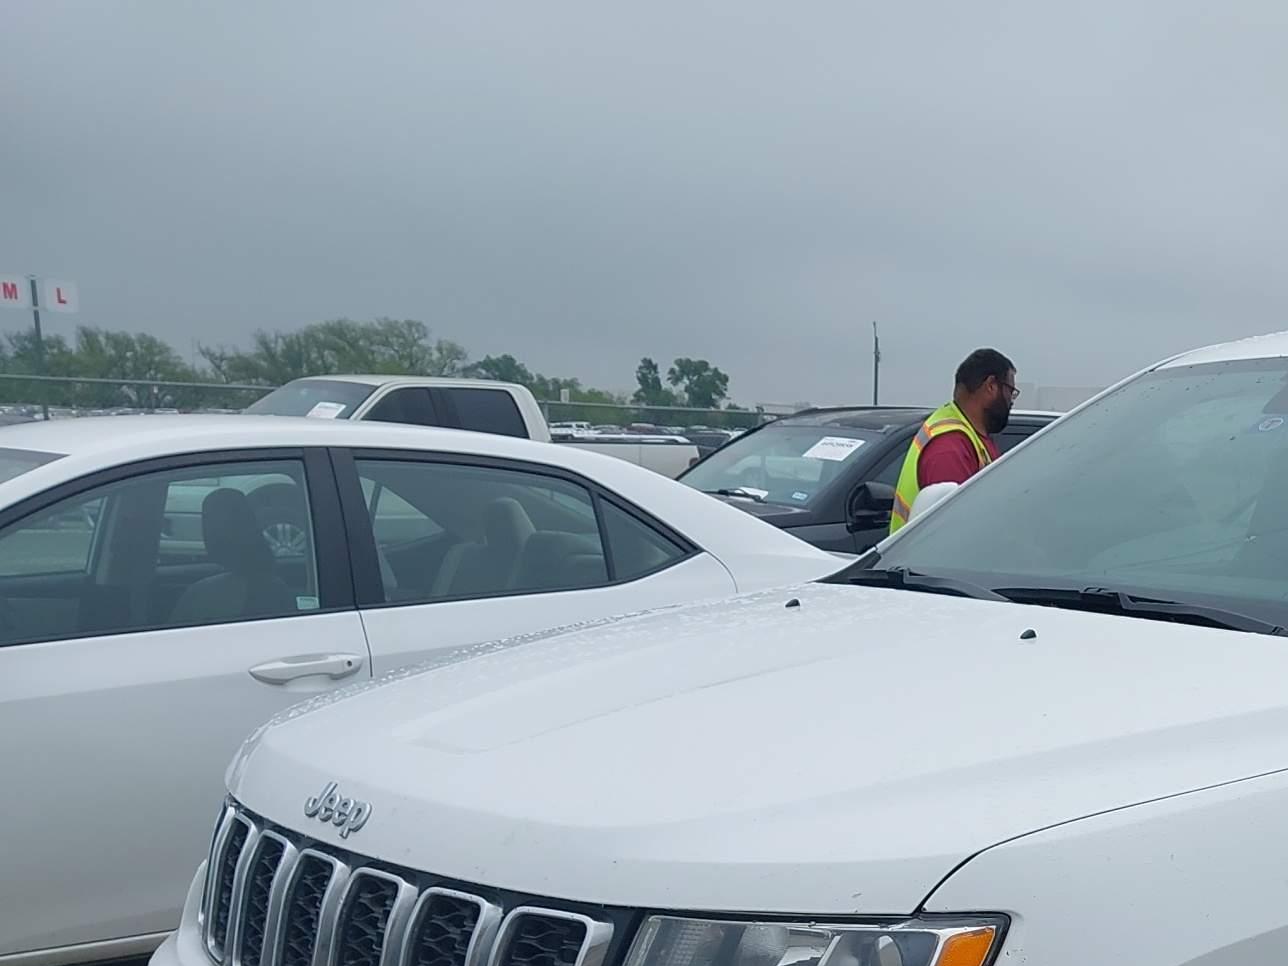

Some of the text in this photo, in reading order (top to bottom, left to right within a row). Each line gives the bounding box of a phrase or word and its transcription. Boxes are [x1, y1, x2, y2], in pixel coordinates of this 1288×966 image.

[2, 282, 18, 300] M
[56, 287, 67, 304] L
[304, 782, 372, 839] Jeep
